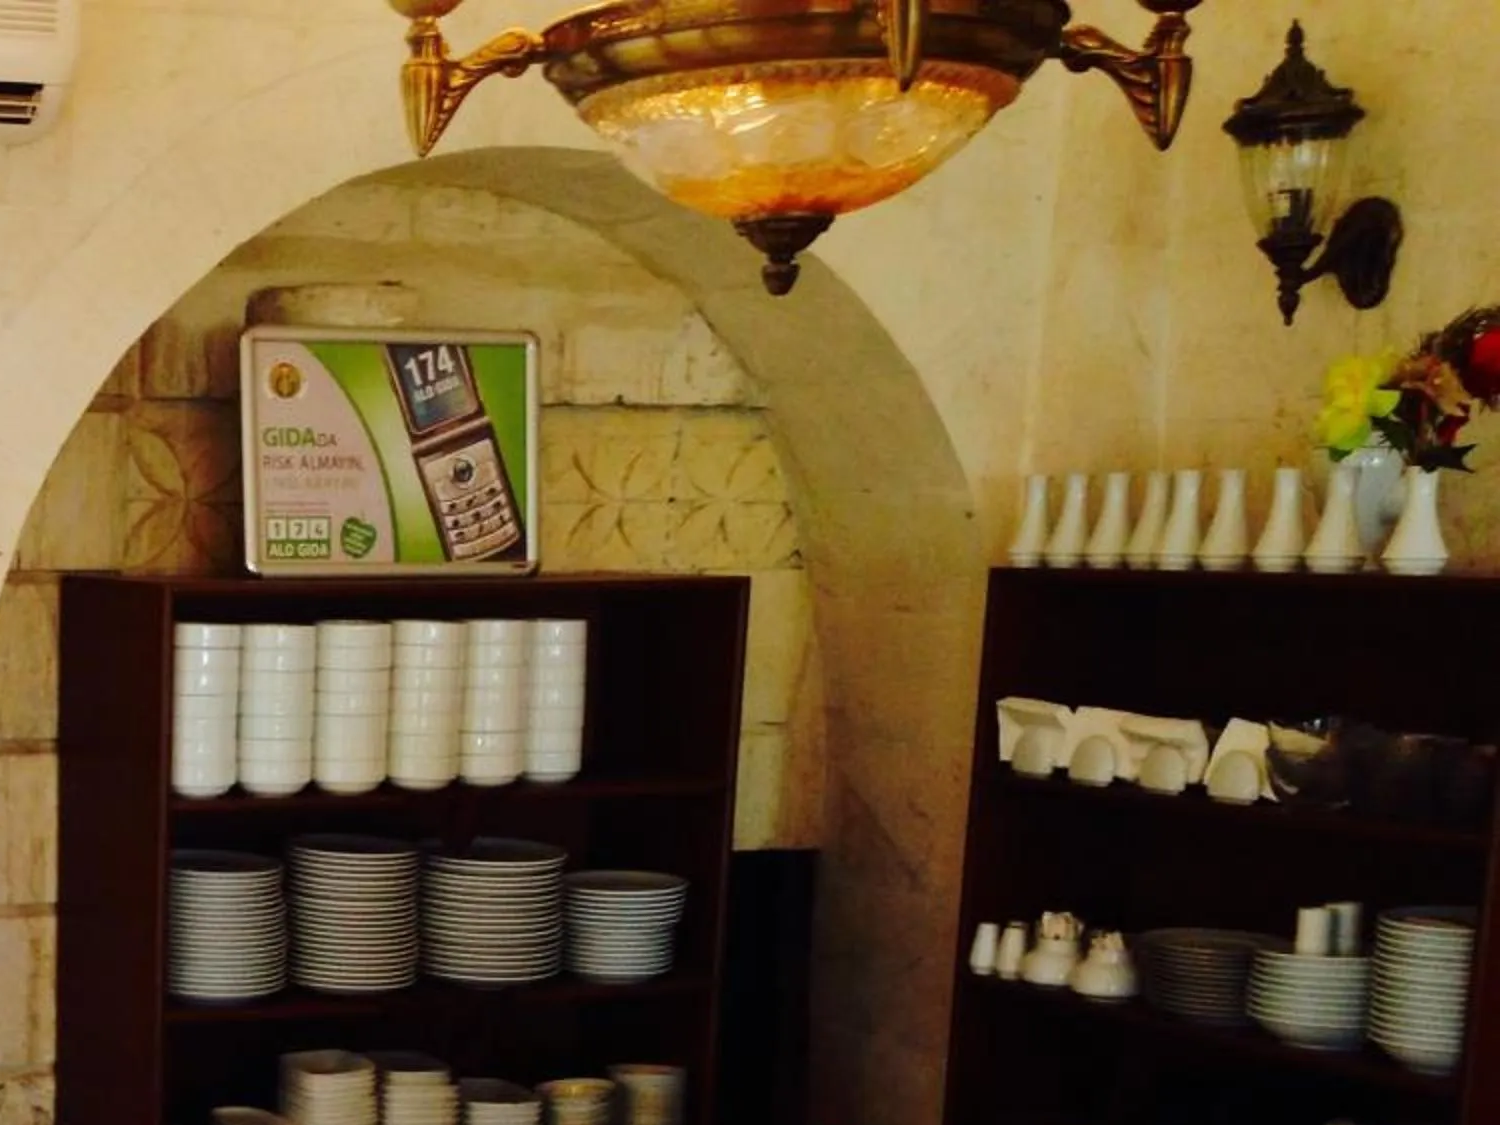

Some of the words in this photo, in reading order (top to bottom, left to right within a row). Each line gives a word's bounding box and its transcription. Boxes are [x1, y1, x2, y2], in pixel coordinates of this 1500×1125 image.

[404, 345, 456, 387] 174
[269, 543, 295, 557] ALO
[296, 543, 329, 557] GIDA
